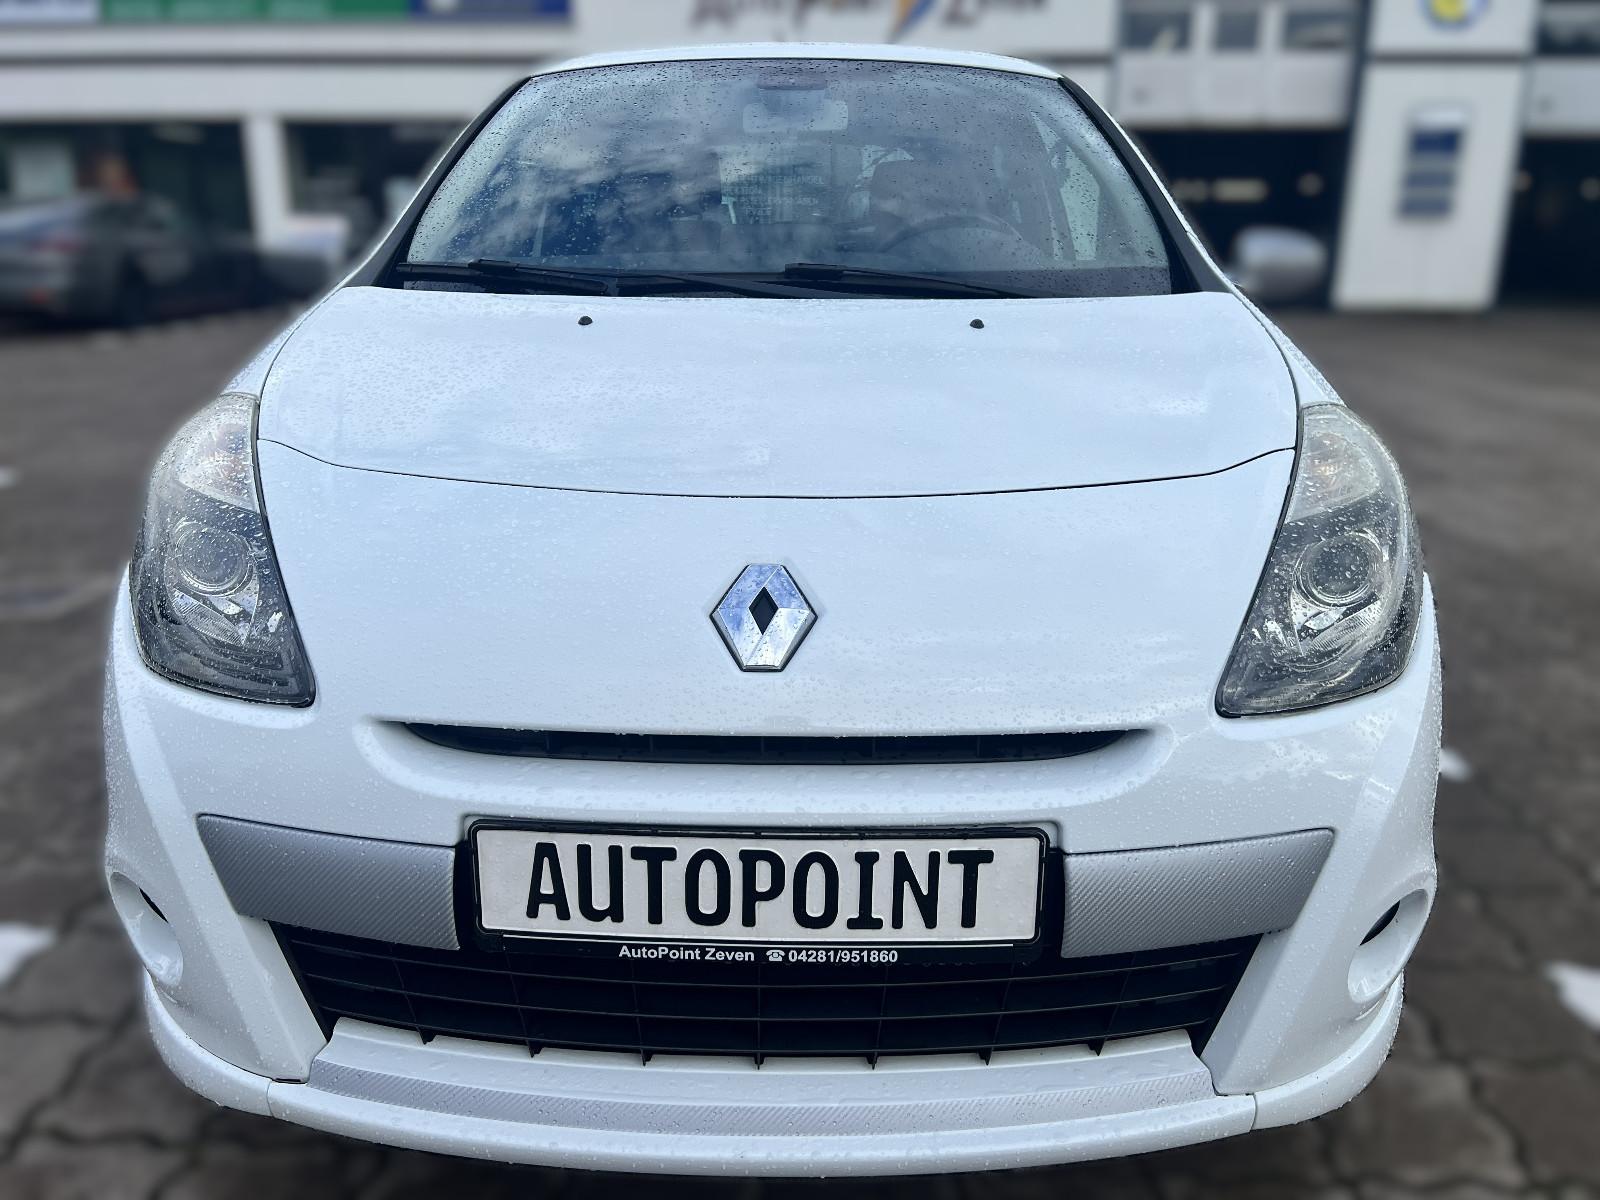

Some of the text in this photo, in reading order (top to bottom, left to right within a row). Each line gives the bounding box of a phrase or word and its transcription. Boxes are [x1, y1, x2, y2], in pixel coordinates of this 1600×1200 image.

[526, 842, 995, 930] AUTOPOINT
[618, 945, 898, 963] AutoPoint Zeven 04281/951860
